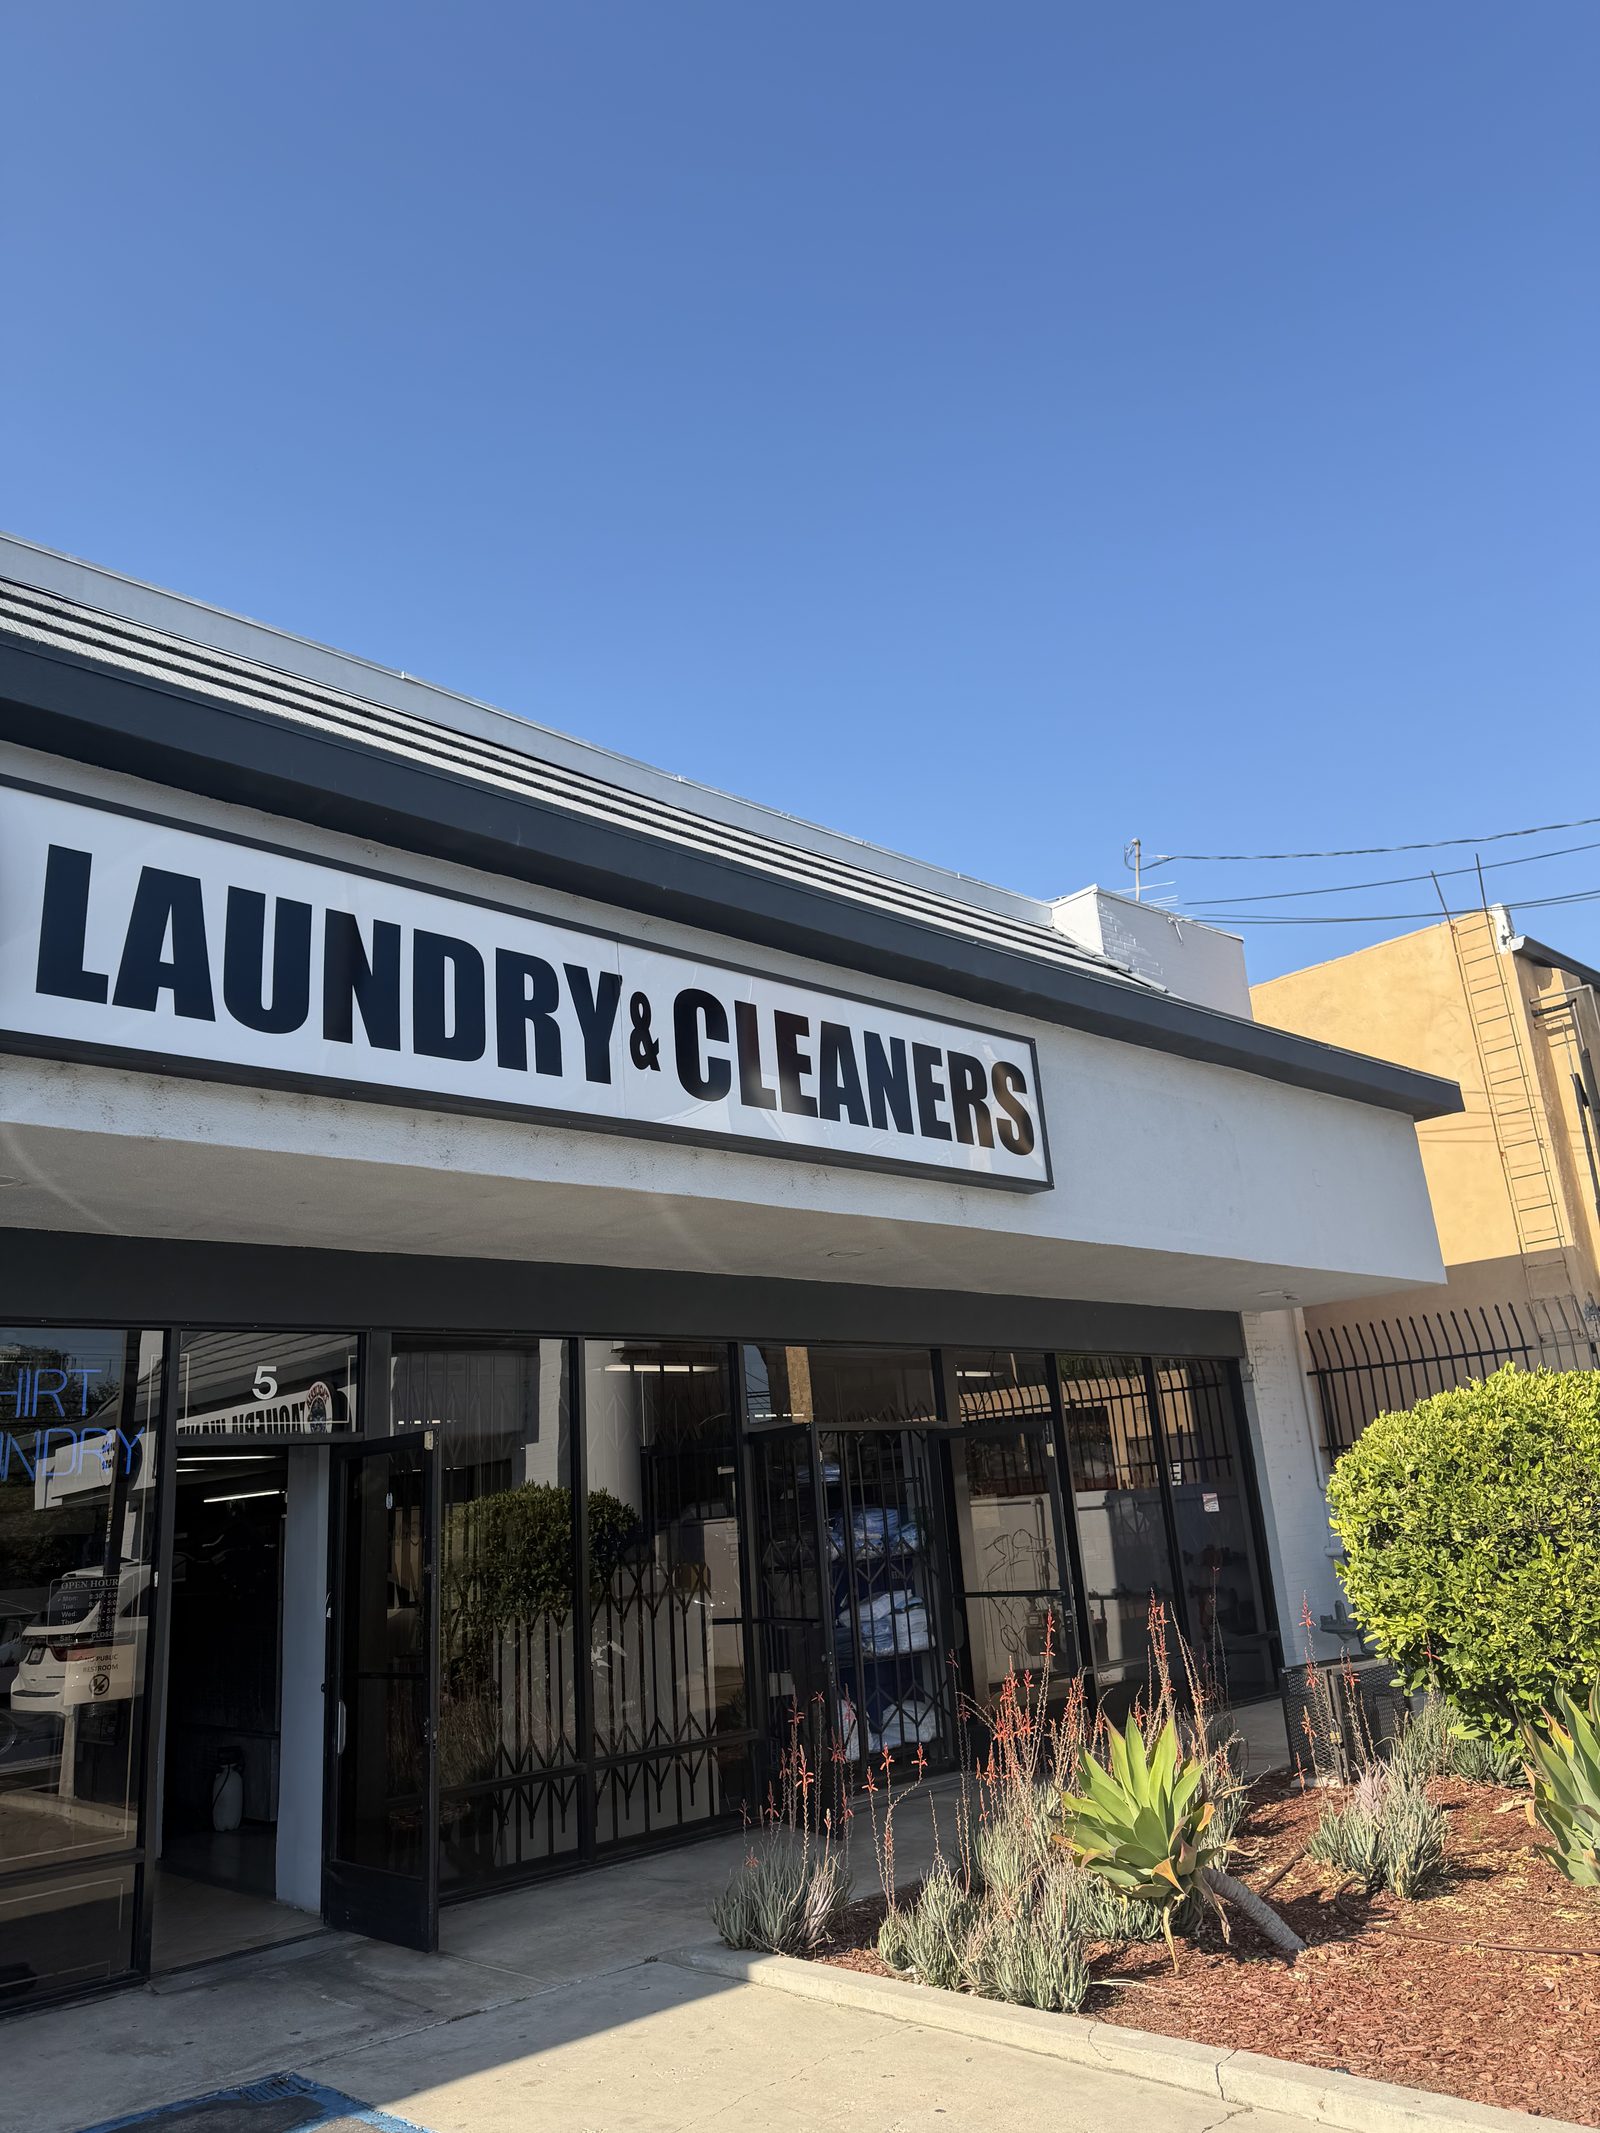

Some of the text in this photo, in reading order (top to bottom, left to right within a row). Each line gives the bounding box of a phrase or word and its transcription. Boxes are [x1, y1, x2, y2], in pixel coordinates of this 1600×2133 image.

[35, 844, 1034, 1156] LAUNDRY & CLEANERS
[251, 1365, 278, 1400] 5
[61, 1580, 88, 1590] OPEN
[96, 1654, 119, 1662] PUBLIC
[83, 1664, 119, 1673] RESTROOM
